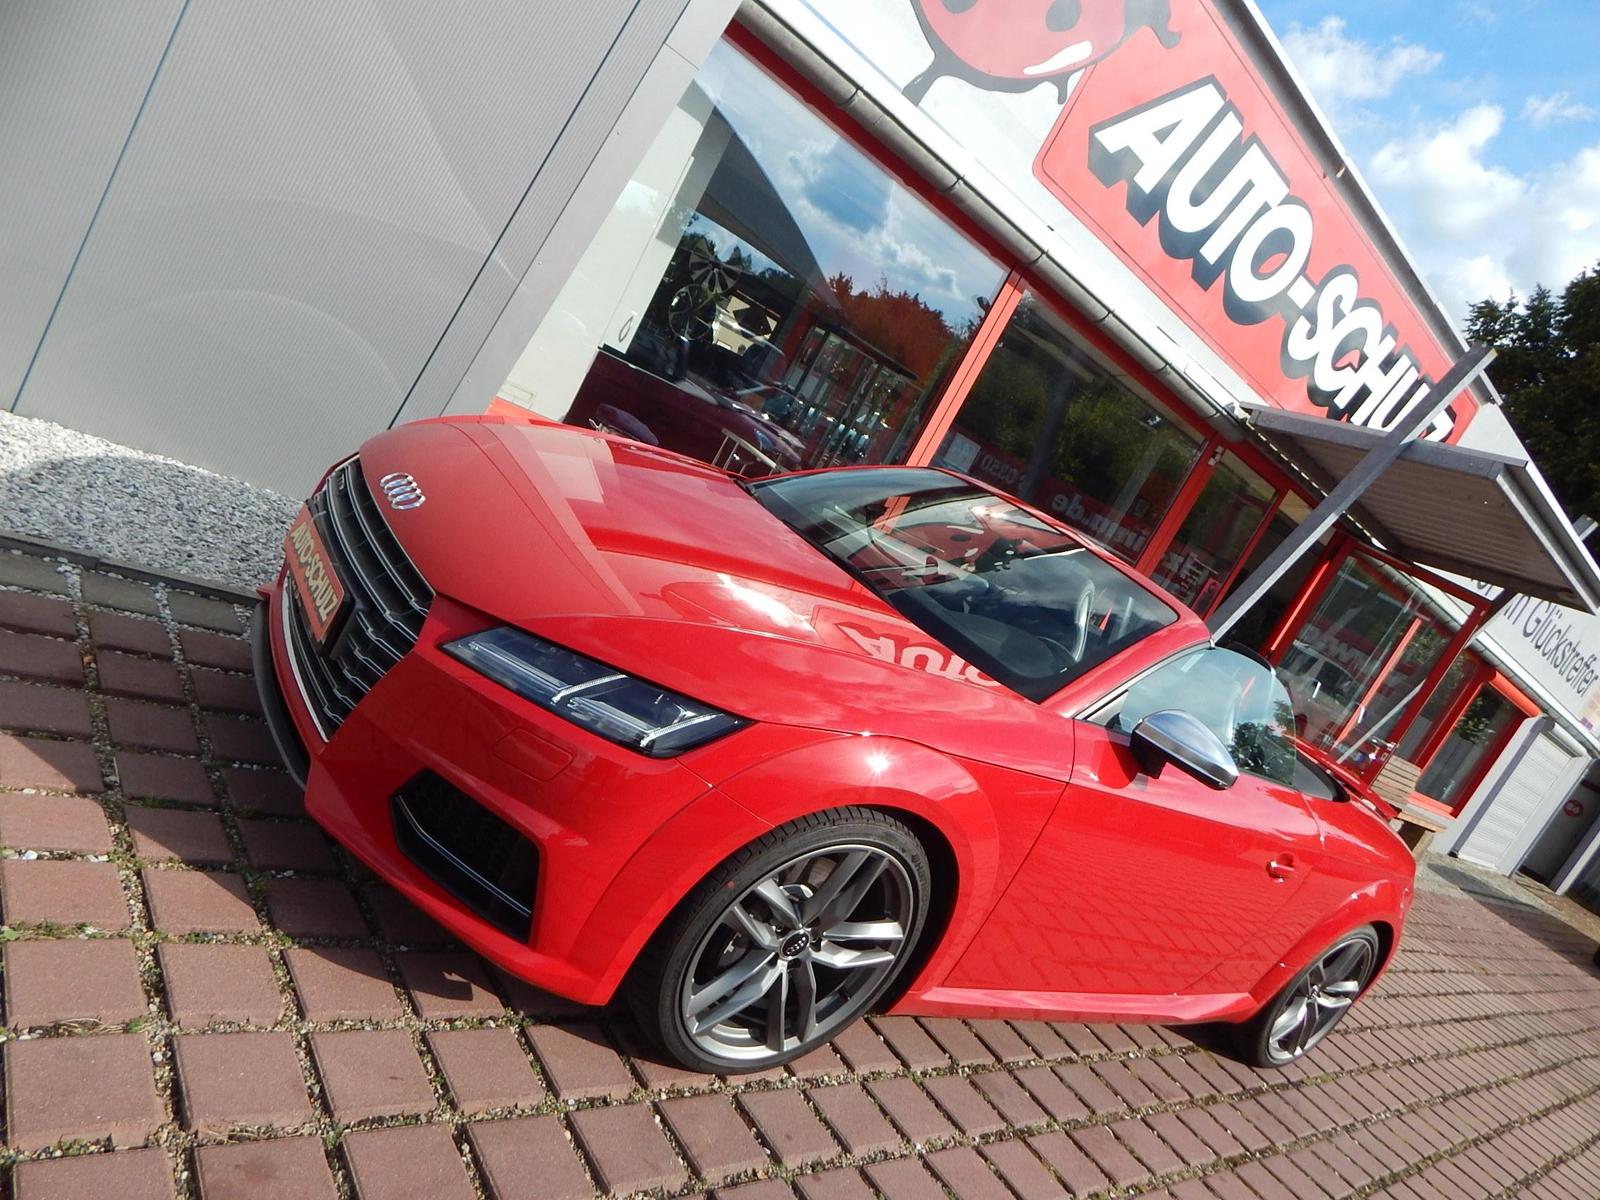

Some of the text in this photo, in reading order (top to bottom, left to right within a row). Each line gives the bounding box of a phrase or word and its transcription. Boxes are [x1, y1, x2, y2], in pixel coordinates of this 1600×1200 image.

[1091, 78, 1456, 442] AUTO-SCHU
[290, 522, 338, 622] AUTO-SCHULZ
[1522, 600, 1599, 698] Glückstreffer
